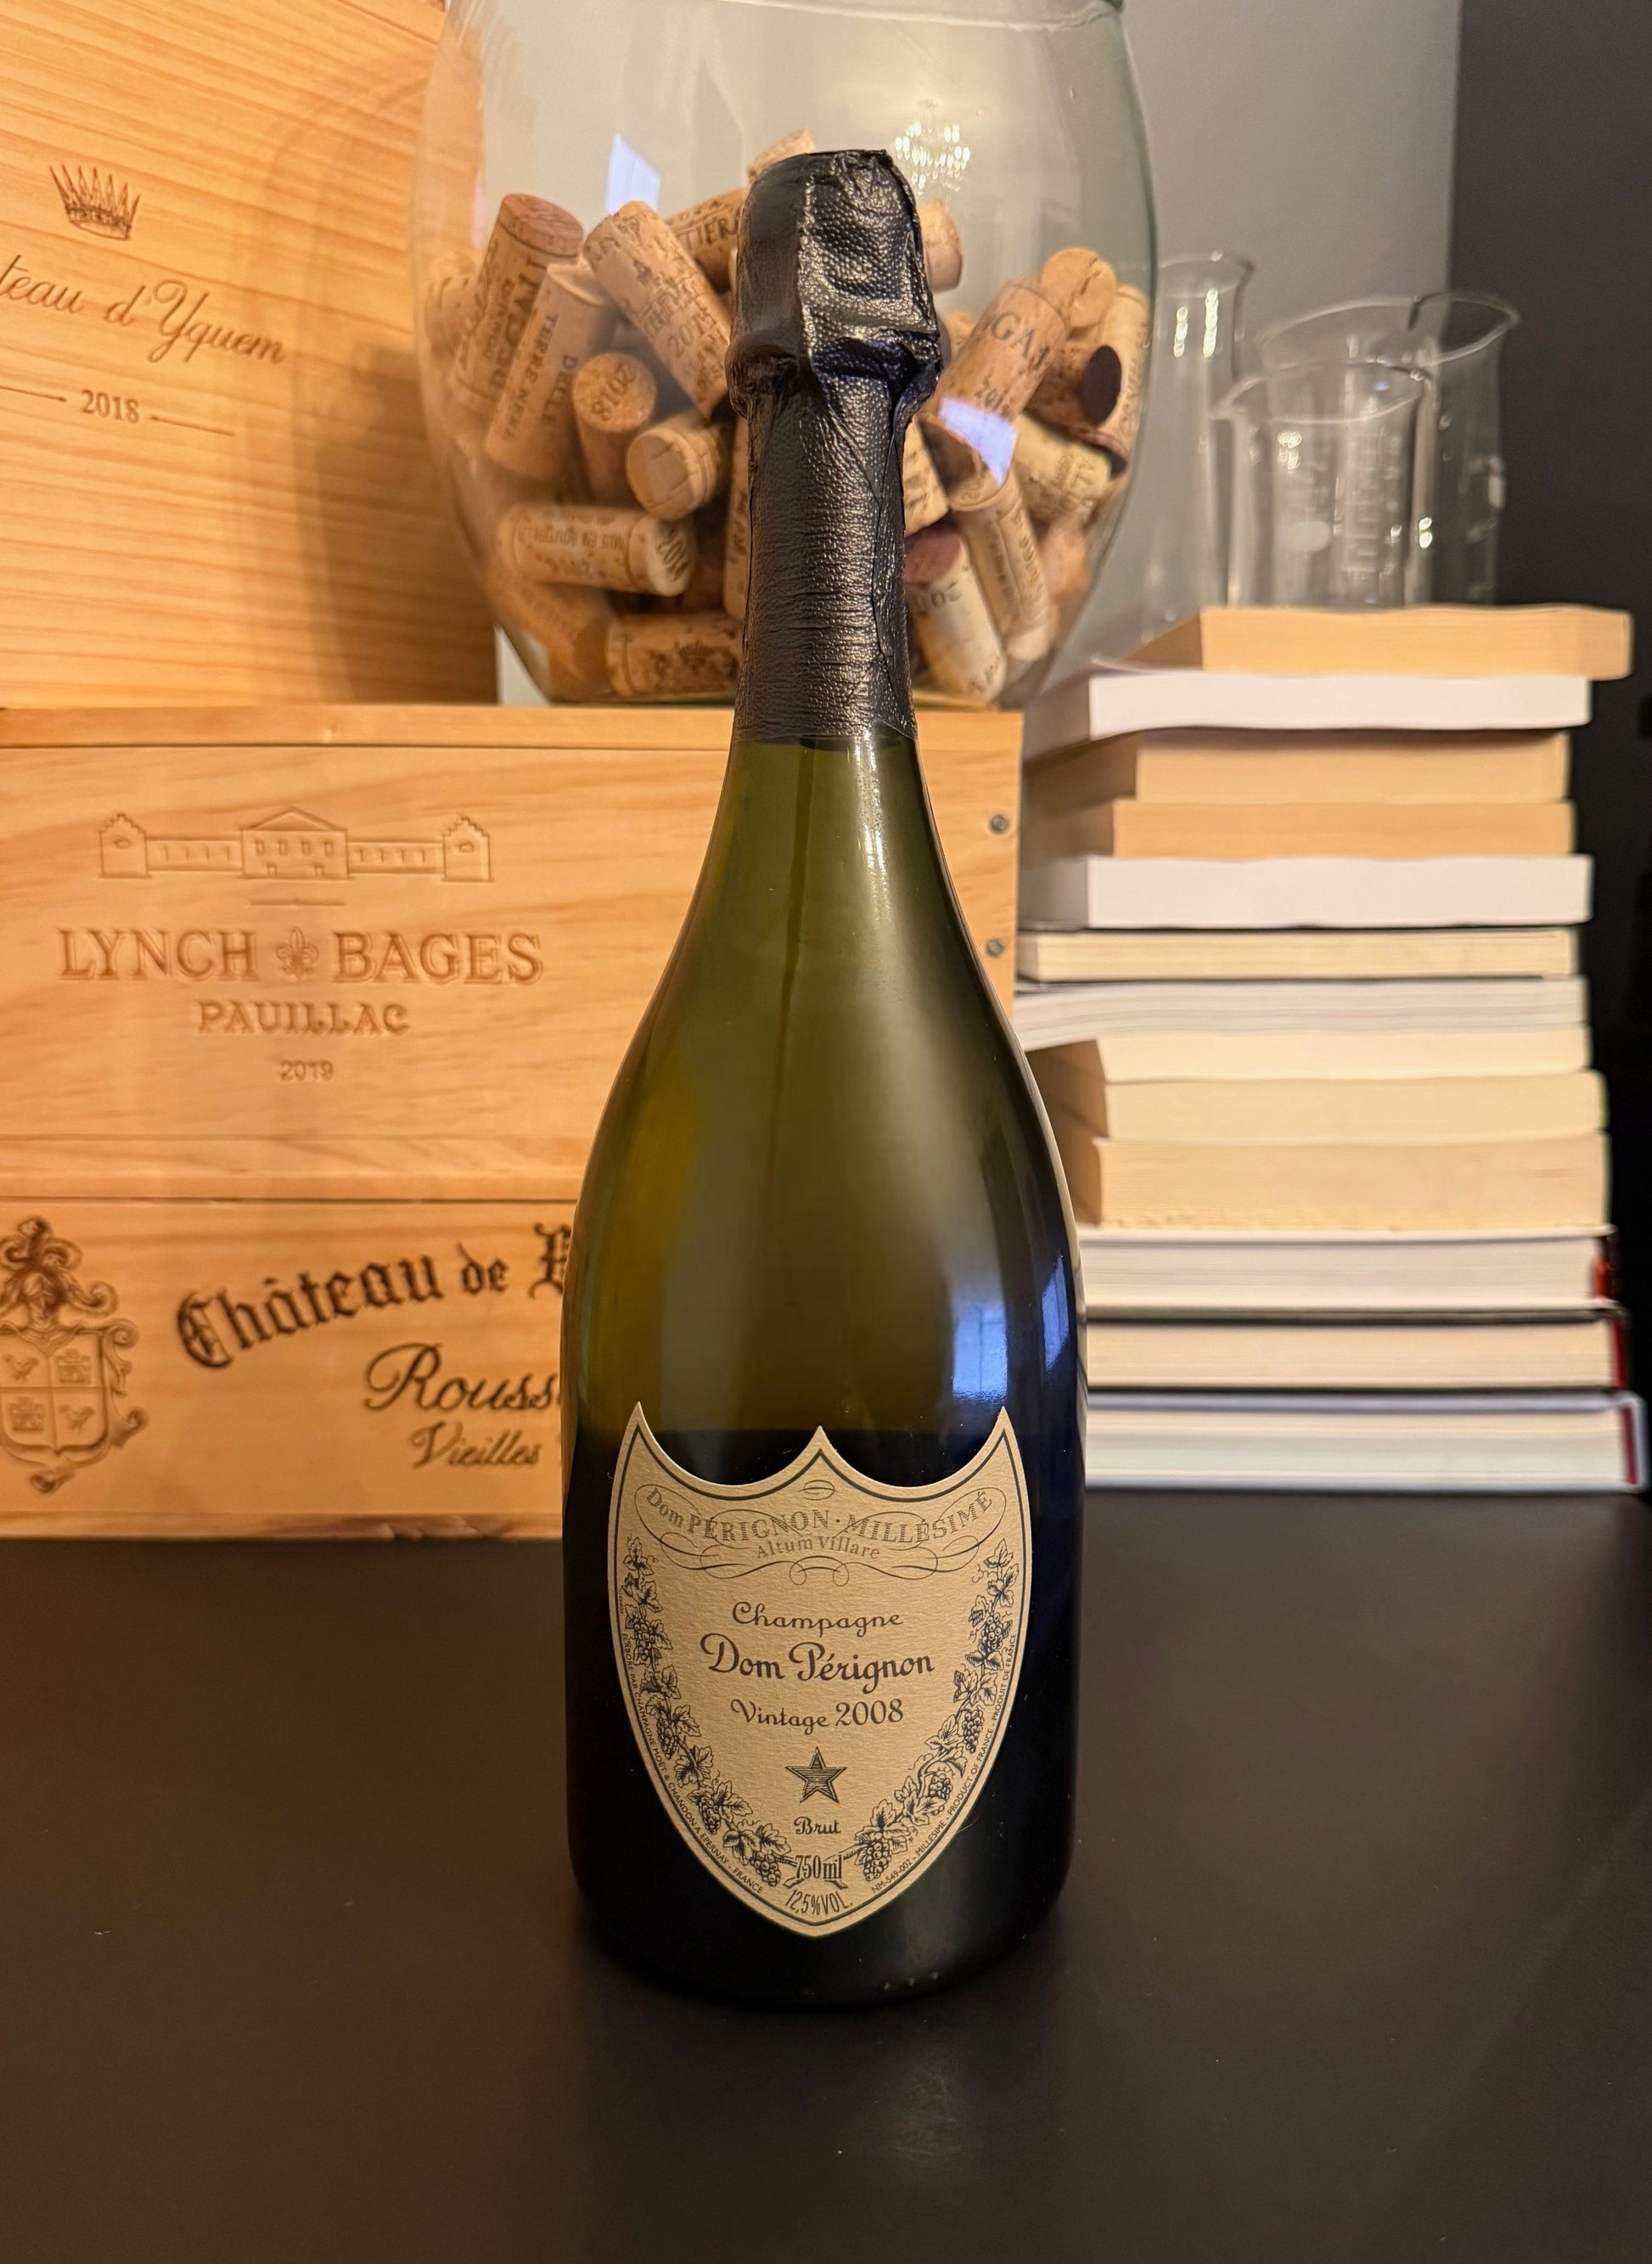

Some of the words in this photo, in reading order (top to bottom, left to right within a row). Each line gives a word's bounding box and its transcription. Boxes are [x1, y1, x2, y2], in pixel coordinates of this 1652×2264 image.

[104, 280, 286, 363] d'Yquem
[81, 389, 140, 424] 2018
[58, 928, 257, 980] LYNCH
[332, 931, 542, 985] BAGES
[197, 999, 410, 1035] PAUILLAC
[279, 1059, 334, 1081] 2019
[177, 1256, 445, 1369] Château
[458, 1243, 509, 1295] de
[363, 1343, 560, 1412] Rouss
[411, 1421, 542, 1469] Vieilles
[646, 1487, 684, 1528] Dom
[756, 1538, 813, 1559] Altum
[732, 1601, 904, 1638] Champagne
[700, 1632, 786, 1681] Dom
[788, 1641, 936, 1695] Pérignon
[730, 1699, 830, 1736] Vintage
[834, 1698, 904, 1727] 2008
[871, 1857, 913, 1894] NM-549-002
[914, 1818, 947, 1857] MILLESIME
[947, 1777, 974, 1817] PRODUCT
[969, 1763, 980, 1775] OF
[976, 1727, 995, 1762] FRANCE
[991, 1683, 1008, 1721] PRODUIT
[1002, 1666, 1010, 1682] DE
[1006, 1633, 1017, 1667] FRANCE
[634, 1692, 657, 1746] CHAMPAGNE
[667, 1782, 699, 1827] CHANDON
[699, 1832, 730, 1865] EPERNAY
[732, 1867, 764, 1895] FRANCE
[793, 1816, 842, 1834] Brut
